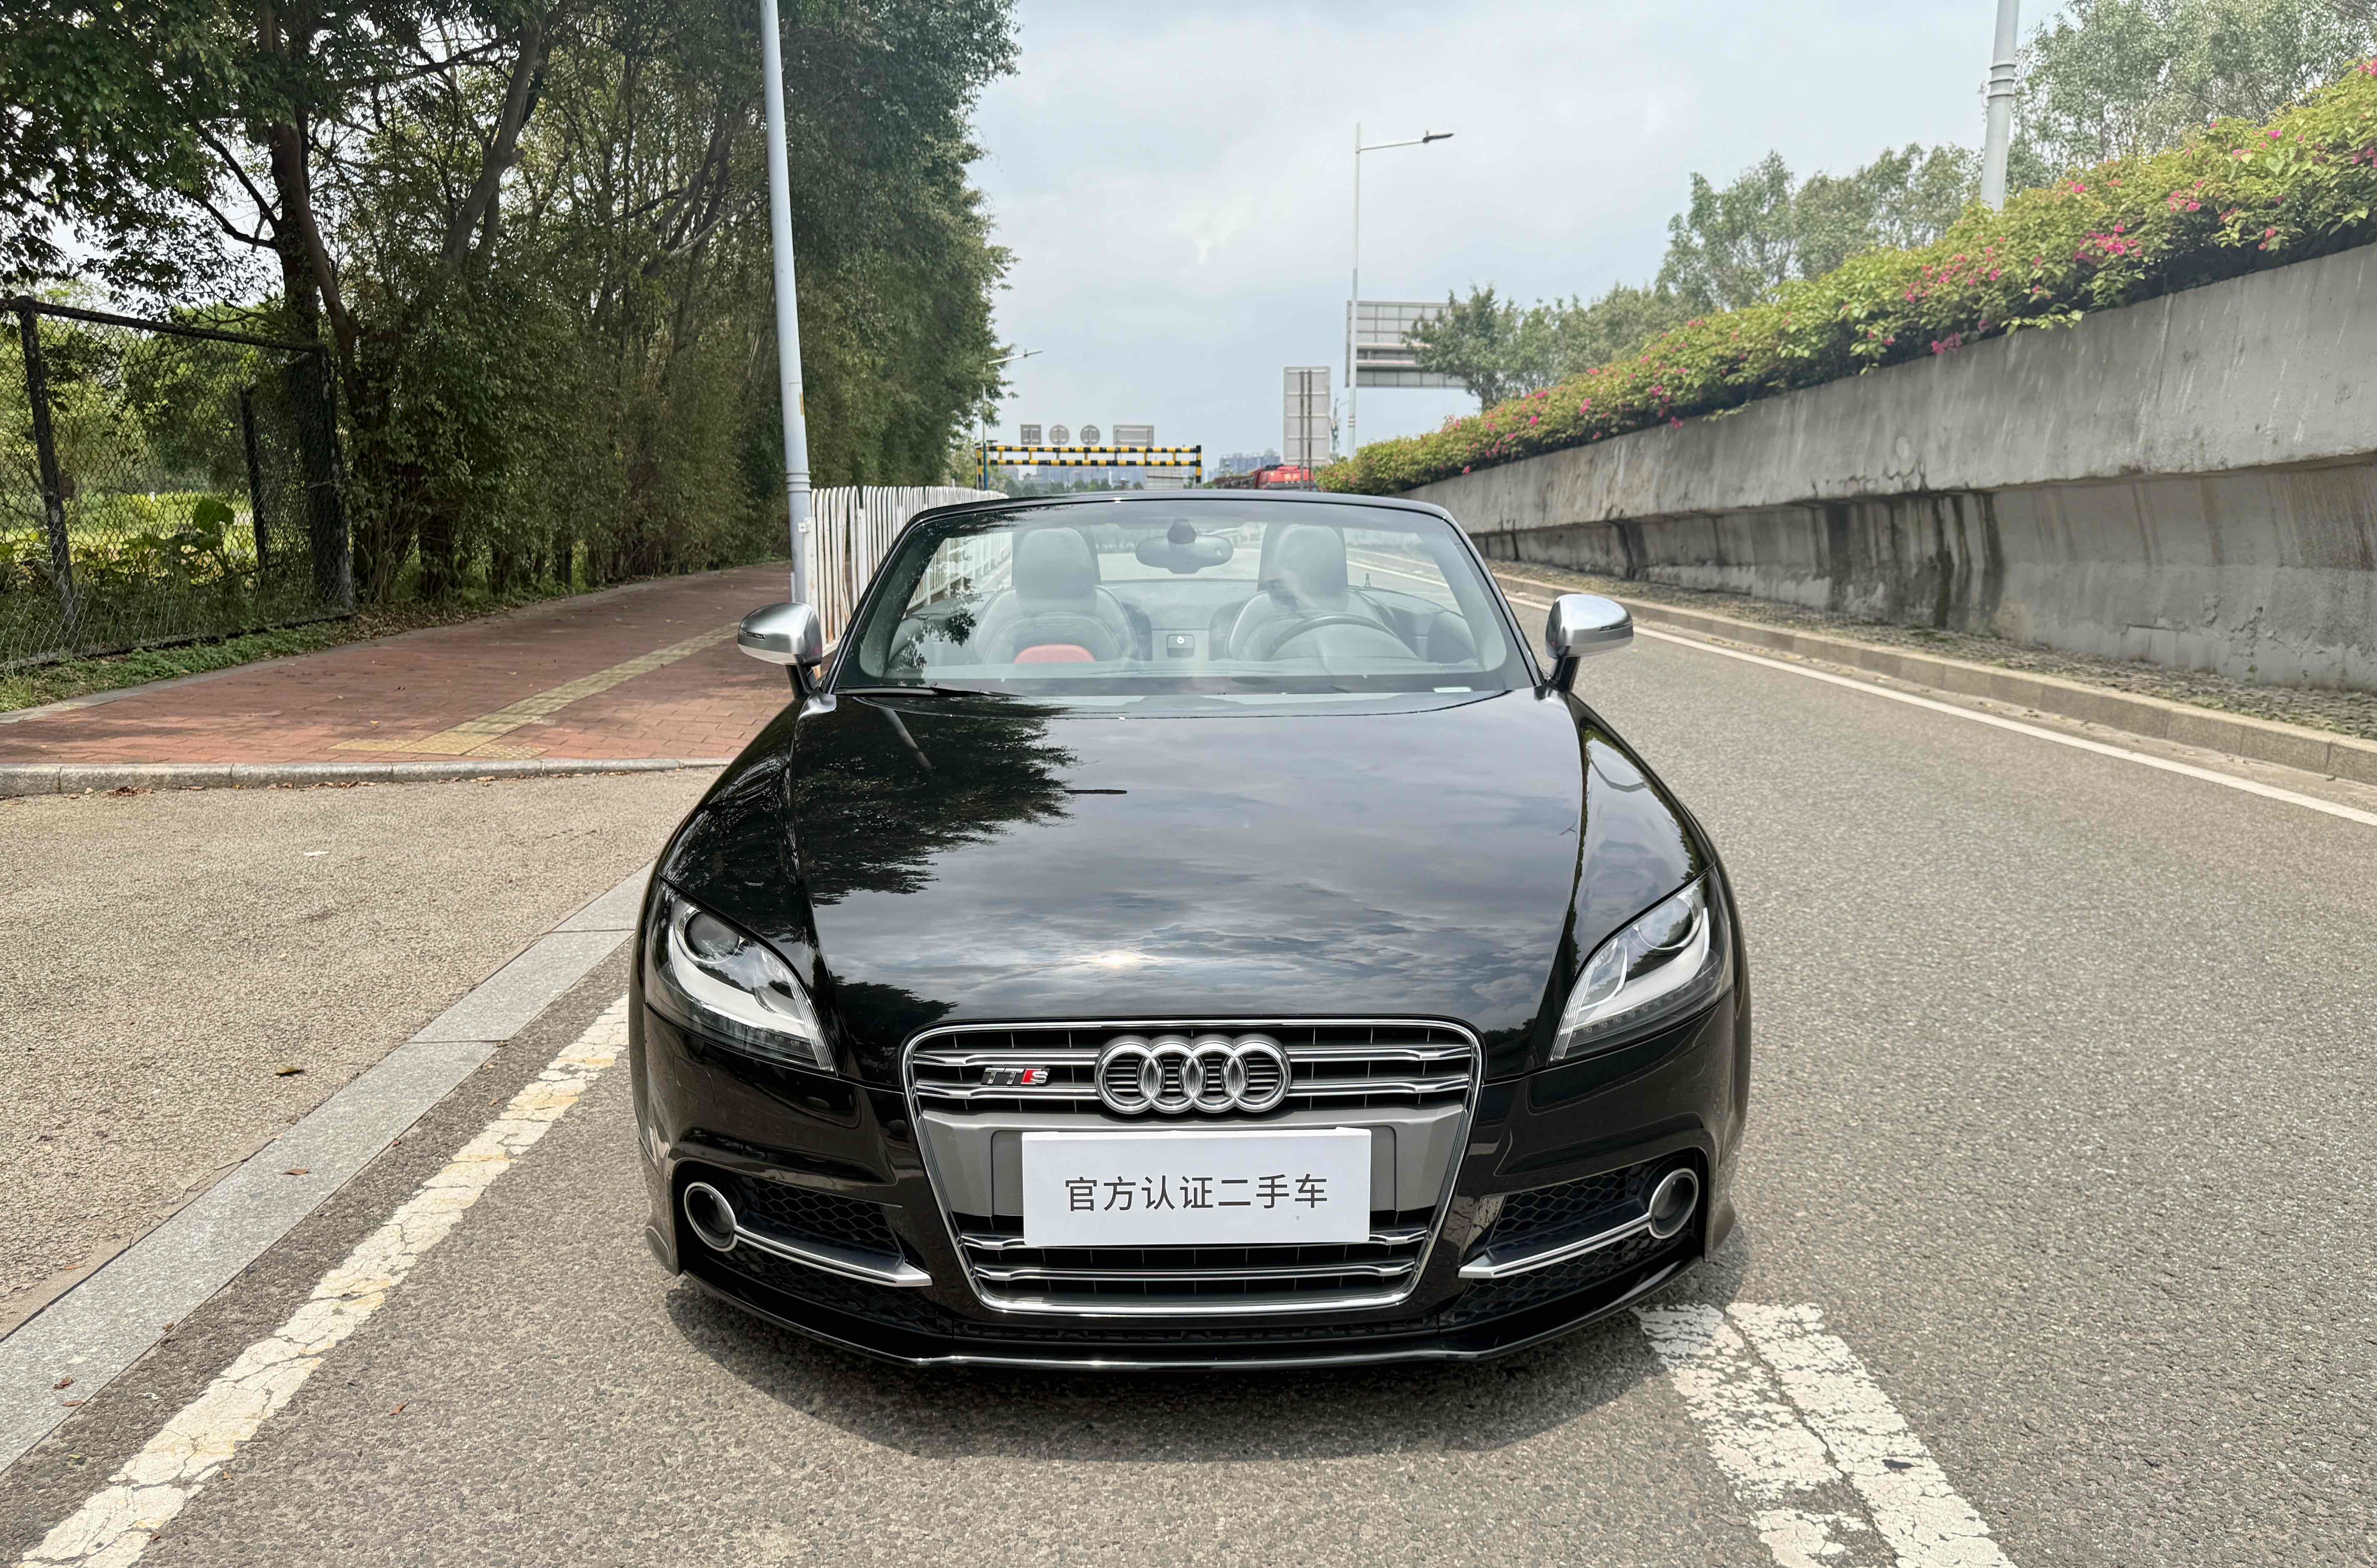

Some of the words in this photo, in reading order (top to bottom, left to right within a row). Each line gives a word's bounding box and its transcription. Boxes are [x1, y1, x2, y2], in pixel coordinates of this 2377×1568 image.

[985, 1067, 1048, 1084] TTS
[1065, 1173, 1327, 1211] 官方认证二手车
